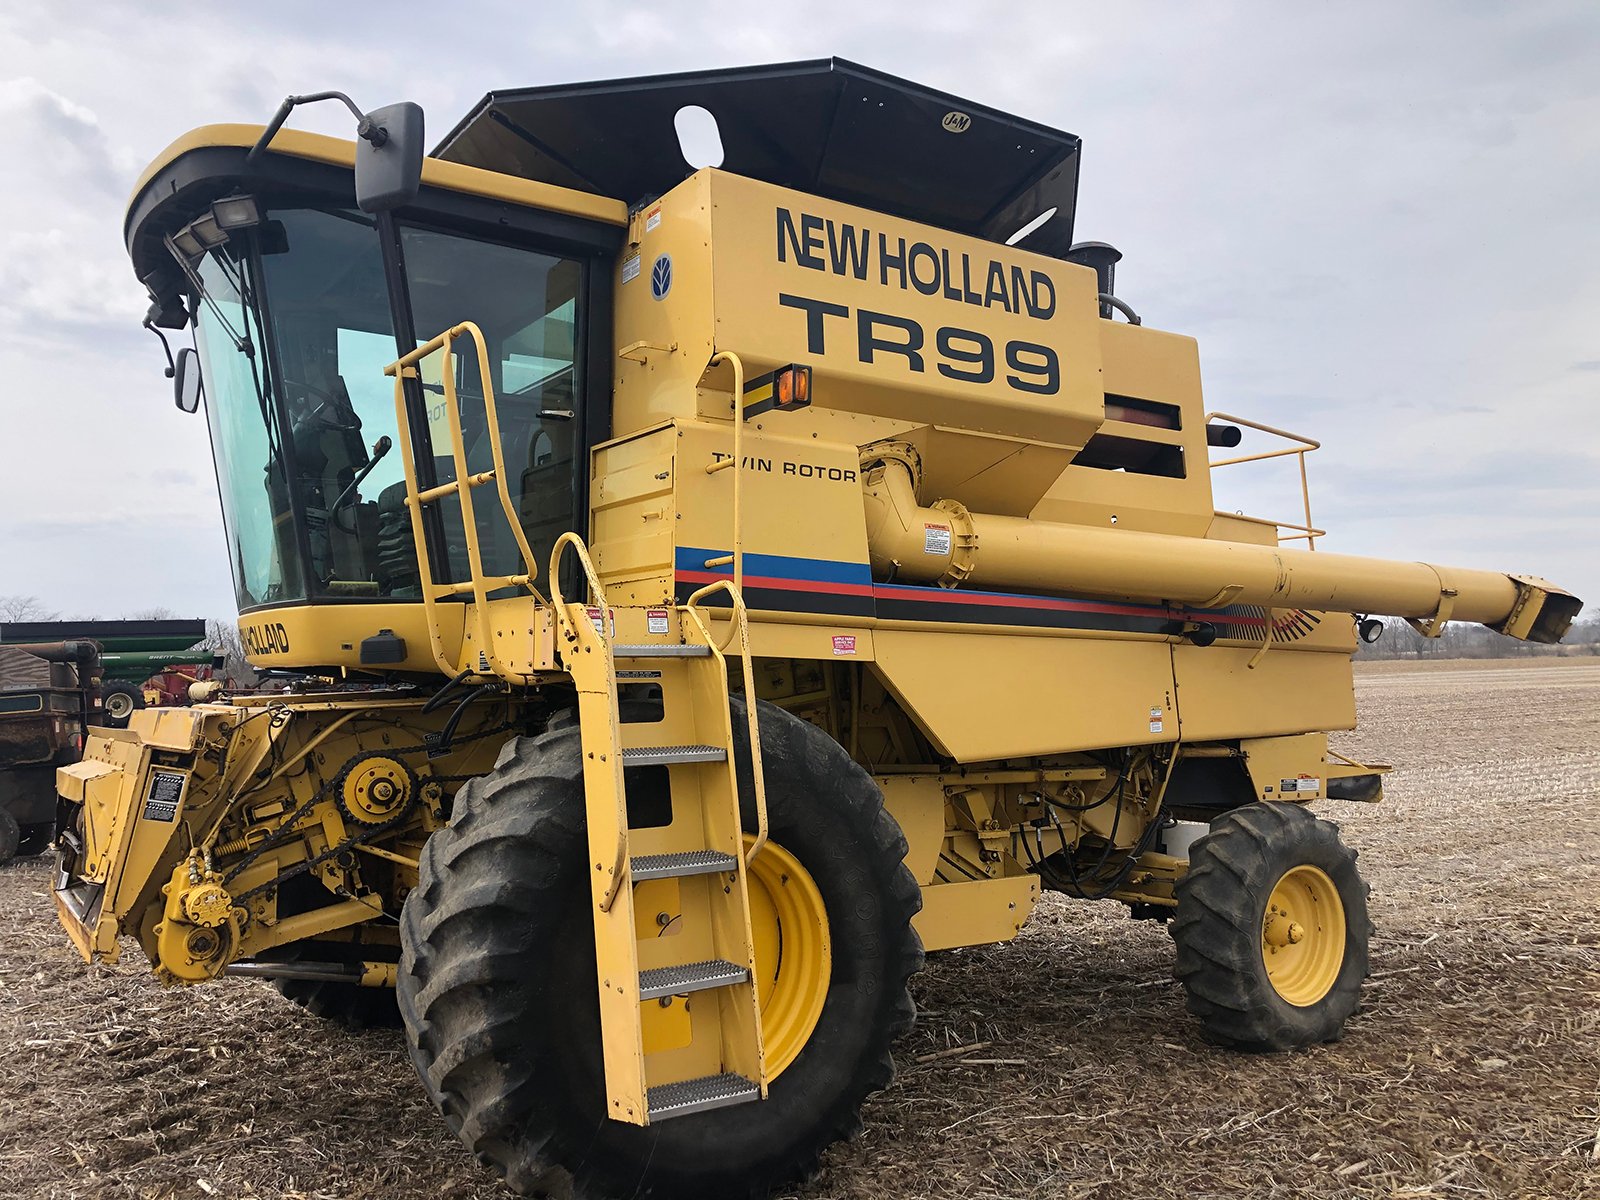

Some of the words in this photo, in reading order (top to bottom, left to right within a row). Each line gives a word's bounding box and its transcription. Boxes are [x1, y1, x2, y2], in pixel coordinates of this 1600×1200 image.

[944, 113, 970, 130] J&M
[776, 206, 870, 281] NEW
[878, 232, 1057, 321] HOLLAND
[779, 292, 1061, 396] TR99
[783, 462, 857, 483] ROTOR
[244, 622, 289, 655] HOLLAND
